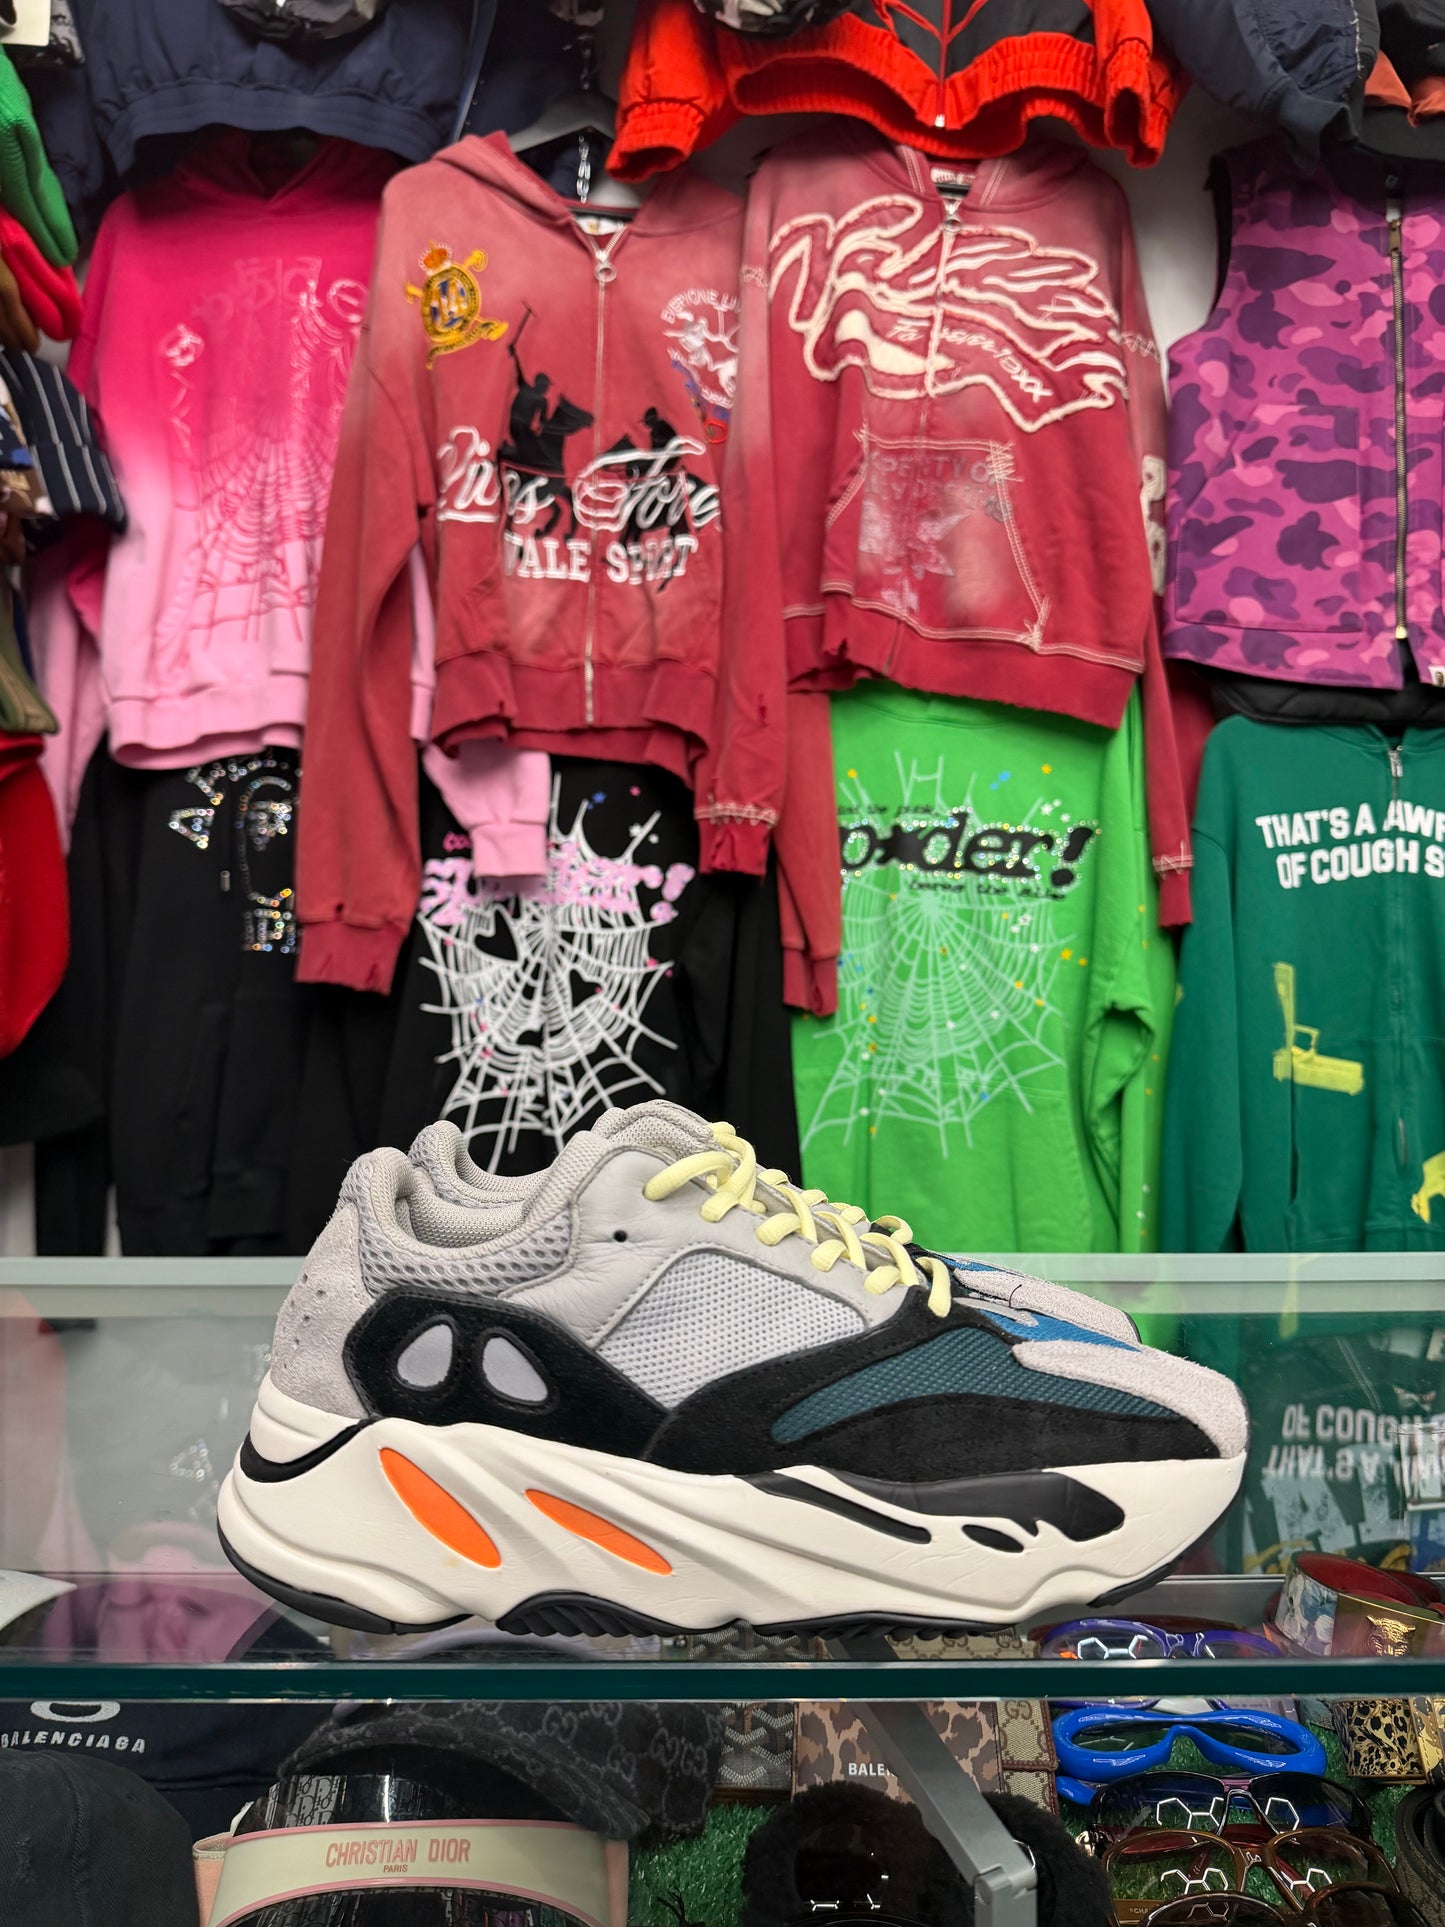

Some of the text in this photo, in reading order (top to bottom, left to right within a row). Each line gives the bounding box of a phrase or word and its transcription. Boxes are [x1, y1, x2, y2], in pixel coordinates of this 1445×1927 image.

[1255, 806, 1350, 849] THAT'S
[1354, 802, 1377, 836] A
[1276, 852, 1307, 889] OF
[1310, 837, 1419, 885] COUGH
[0, 1730, 146, 1753] BALENCIAGA
[848, 1762, 894, 1777] BALE
[325, 1838, 471, 1867] CHRISTIAN DIOR
[383, 1864, 408, 1873] PARIS
